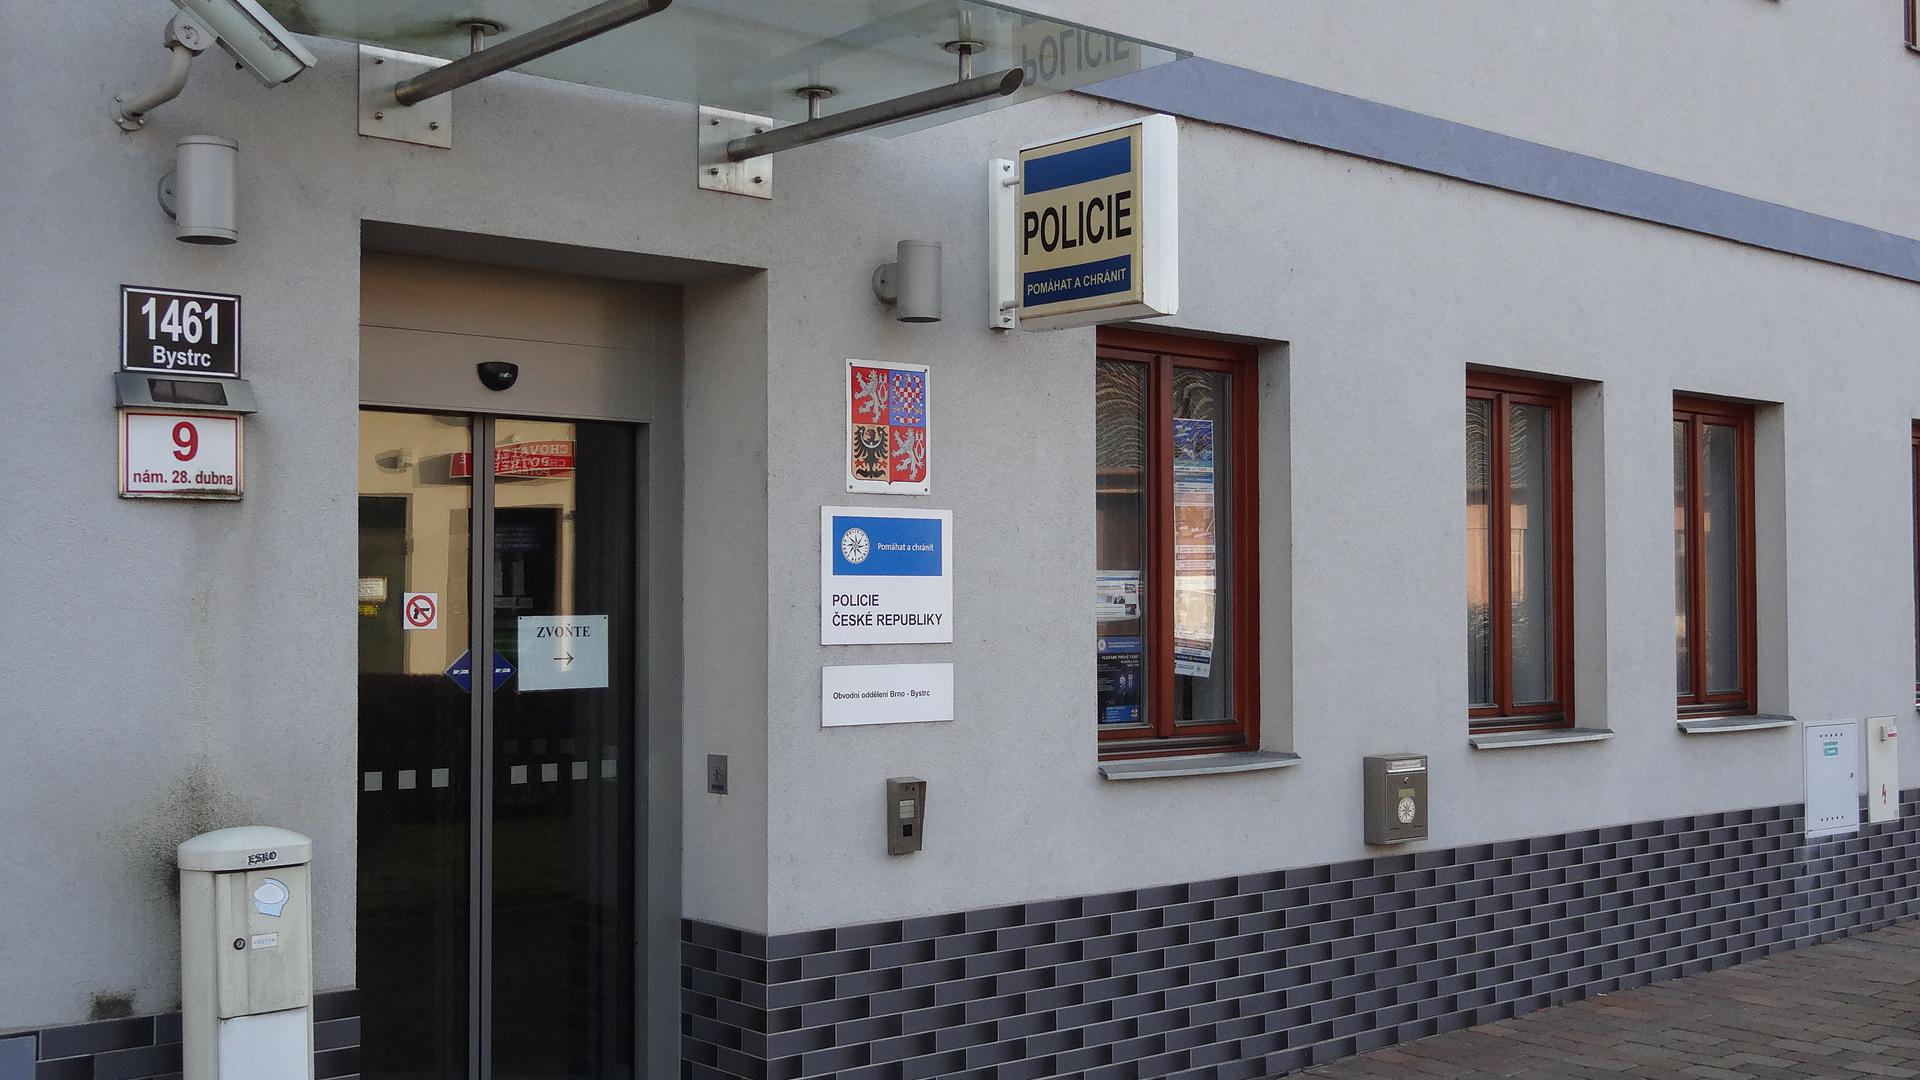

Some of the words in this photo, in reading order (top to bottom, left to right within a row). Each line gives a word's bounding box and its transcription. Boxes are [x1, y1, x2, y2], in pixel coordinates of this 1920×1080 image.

[1024, 190, 1131, 256] POLICIE
[1027, 277, 1072, 295] POMÁHAT
[1074, 276, 1081, 288] A
[1083, 268, 1126, 287] CHRÁNIT
[142, 297, 219, 345] 1461
[153, 345, 212, 369] Bystrc
[172, 421, 199, 462] 9
[133, 470, 168, 484] nám.
[172, 470, 191, 484] 28.
[195, 471, 233, 485] dubna
[877, 542, 906, 551] Pomáhat
[912, 542, 934, 551] chránit
[832, 594, 879, 607] POLICIE
[832, 611, 873, 627] ČESKÉ
[876, 613, 943, 626] REPUBLIKY
[536, 623, 591, 638] ZVOŇTE
[832, 691, 860, 700] Obvodní
[861, 691, 888, 699] oddělení
[890, 690, 905, 698] Brno
[910, 689, 930, 699] Bystrc
